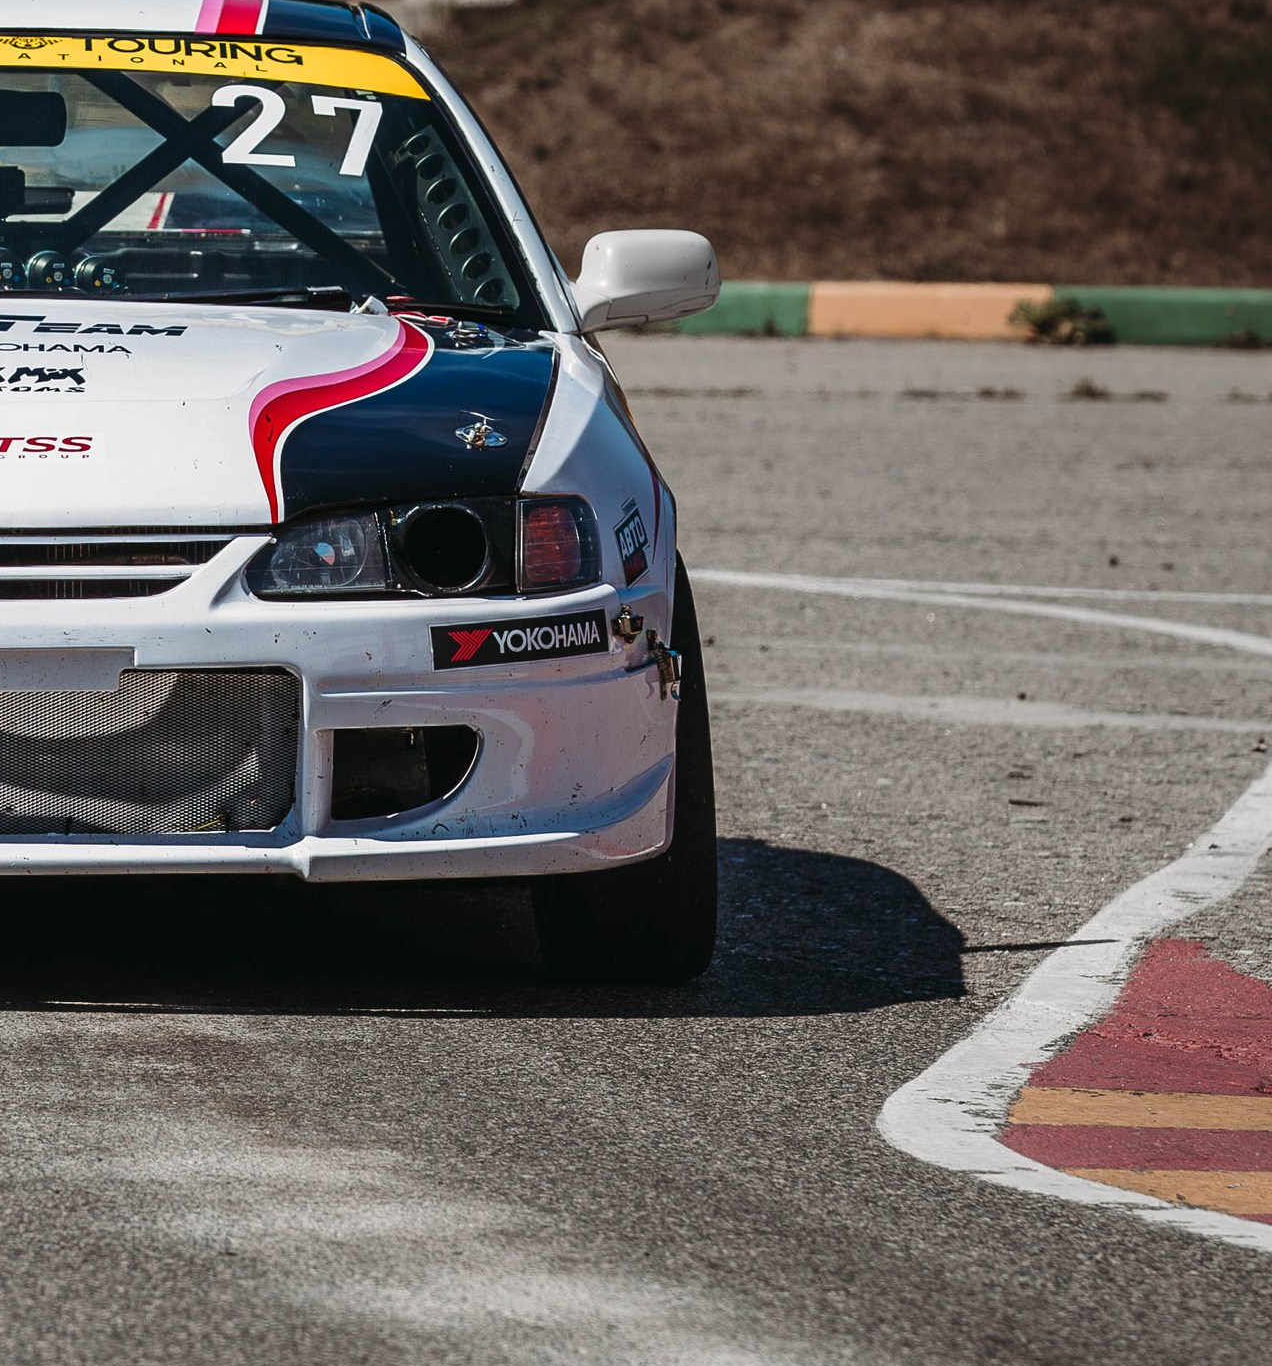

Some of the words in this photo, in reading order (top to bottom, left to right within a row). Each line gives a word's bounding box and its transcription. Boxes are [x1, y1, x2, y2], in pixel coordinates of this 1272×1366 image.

[70, 37, 304, 66] TOURING
[211, 84, 384, 177] 27
[618, 515, 646, 562] АВТО
[492, 621, 601, 655] YOKOHAMA
